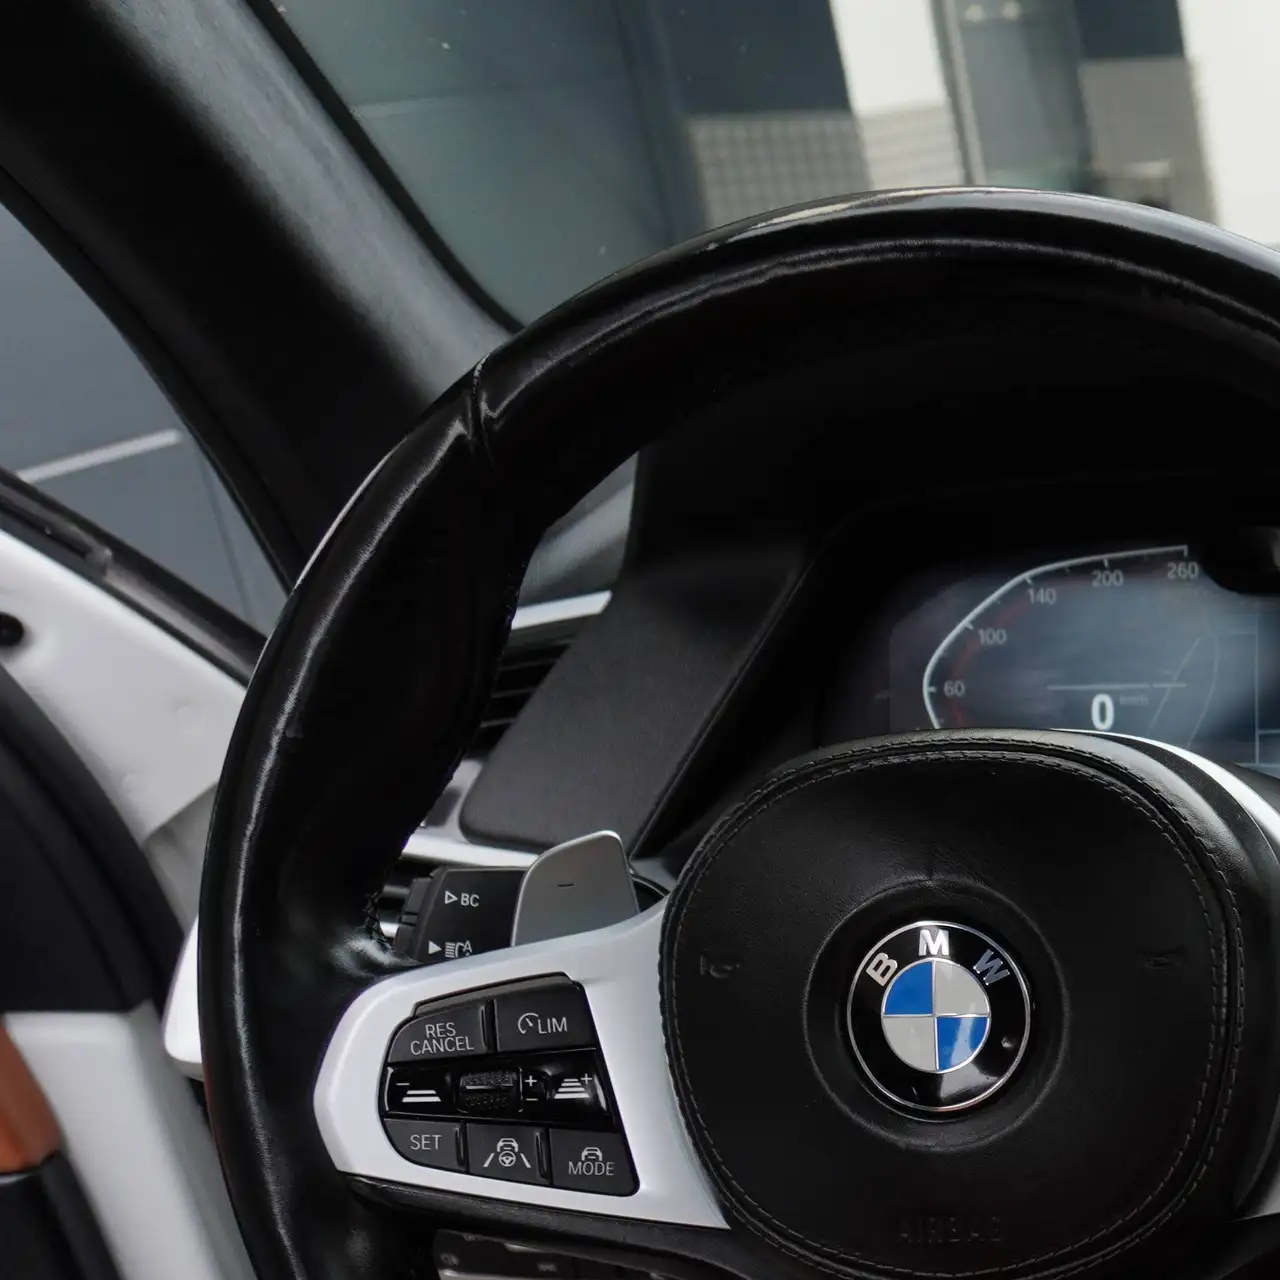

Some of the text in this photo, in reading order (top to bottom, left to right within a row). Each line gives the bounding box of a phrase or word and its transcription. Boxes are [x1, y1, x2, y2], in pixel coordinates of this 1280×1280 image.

[1092, 570, 1123, 587] 200
[1167, 562, 1199, 579] 260
[1028, 588, 1056, 605] 140
[978, 628, 1006, 645] 100
[944, 681, 965, 697] 60
[1091, 694, 1115, 731] 0
[460, 892, 480, 907] BC
[865, 928, 1011, 987] BMW
[425, 1022, 456, 1038] RES
[538, 1017, 568, 1036] LIM
[410, 1036, 475, 1056] CANCEL
[410, 1134, 442, 1151] SET
[568, 1160, 615, 1177] MODE
